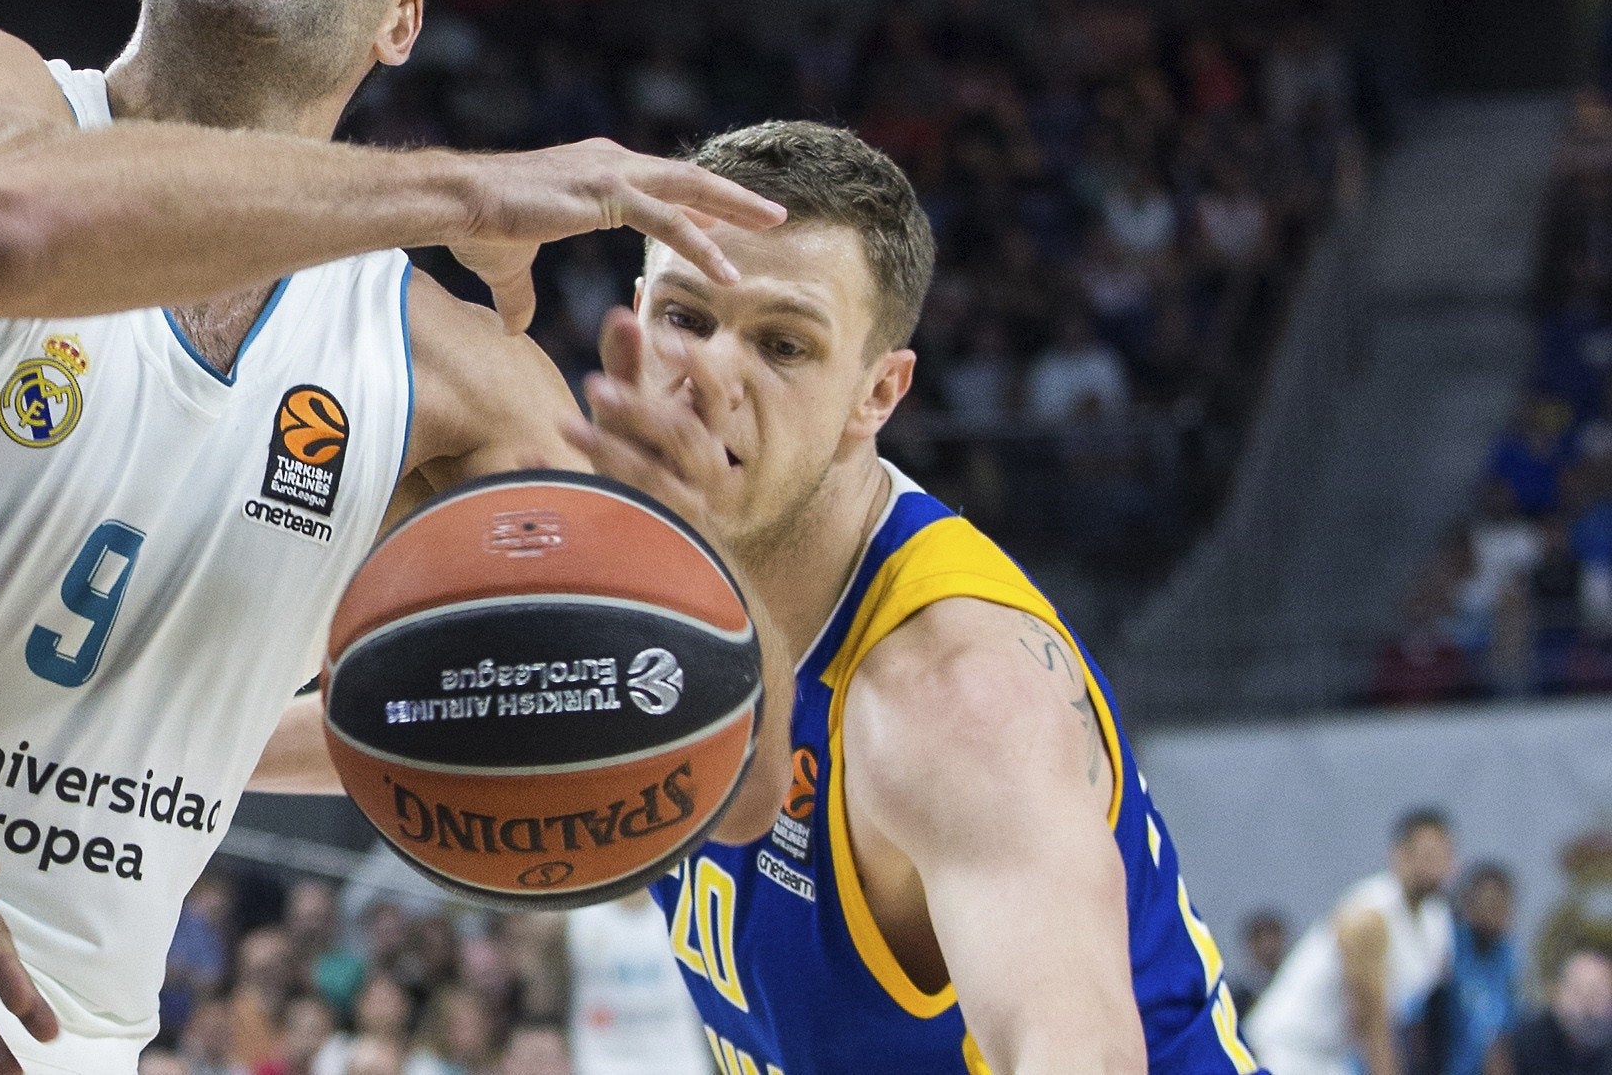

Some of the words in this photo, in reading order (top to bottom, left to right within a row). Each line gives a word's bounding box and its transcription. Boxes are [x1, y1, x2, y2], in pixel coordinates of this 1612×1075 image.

[273, 468, 330, 496] AIRLINES
[277, 455, 333, 484] TURKISH
[271, 480, 326, 507] EuroLeague
[244, 500, 332, 542] oneteam
[25, 519, 146, 688] 9
[441, 657, 619, 691] EuroLeague
[385, 692, 493, 725] AIRLINES
[497, 687, 622, 718] TURKISH
[392, 762, 697, 856] SPALDING
